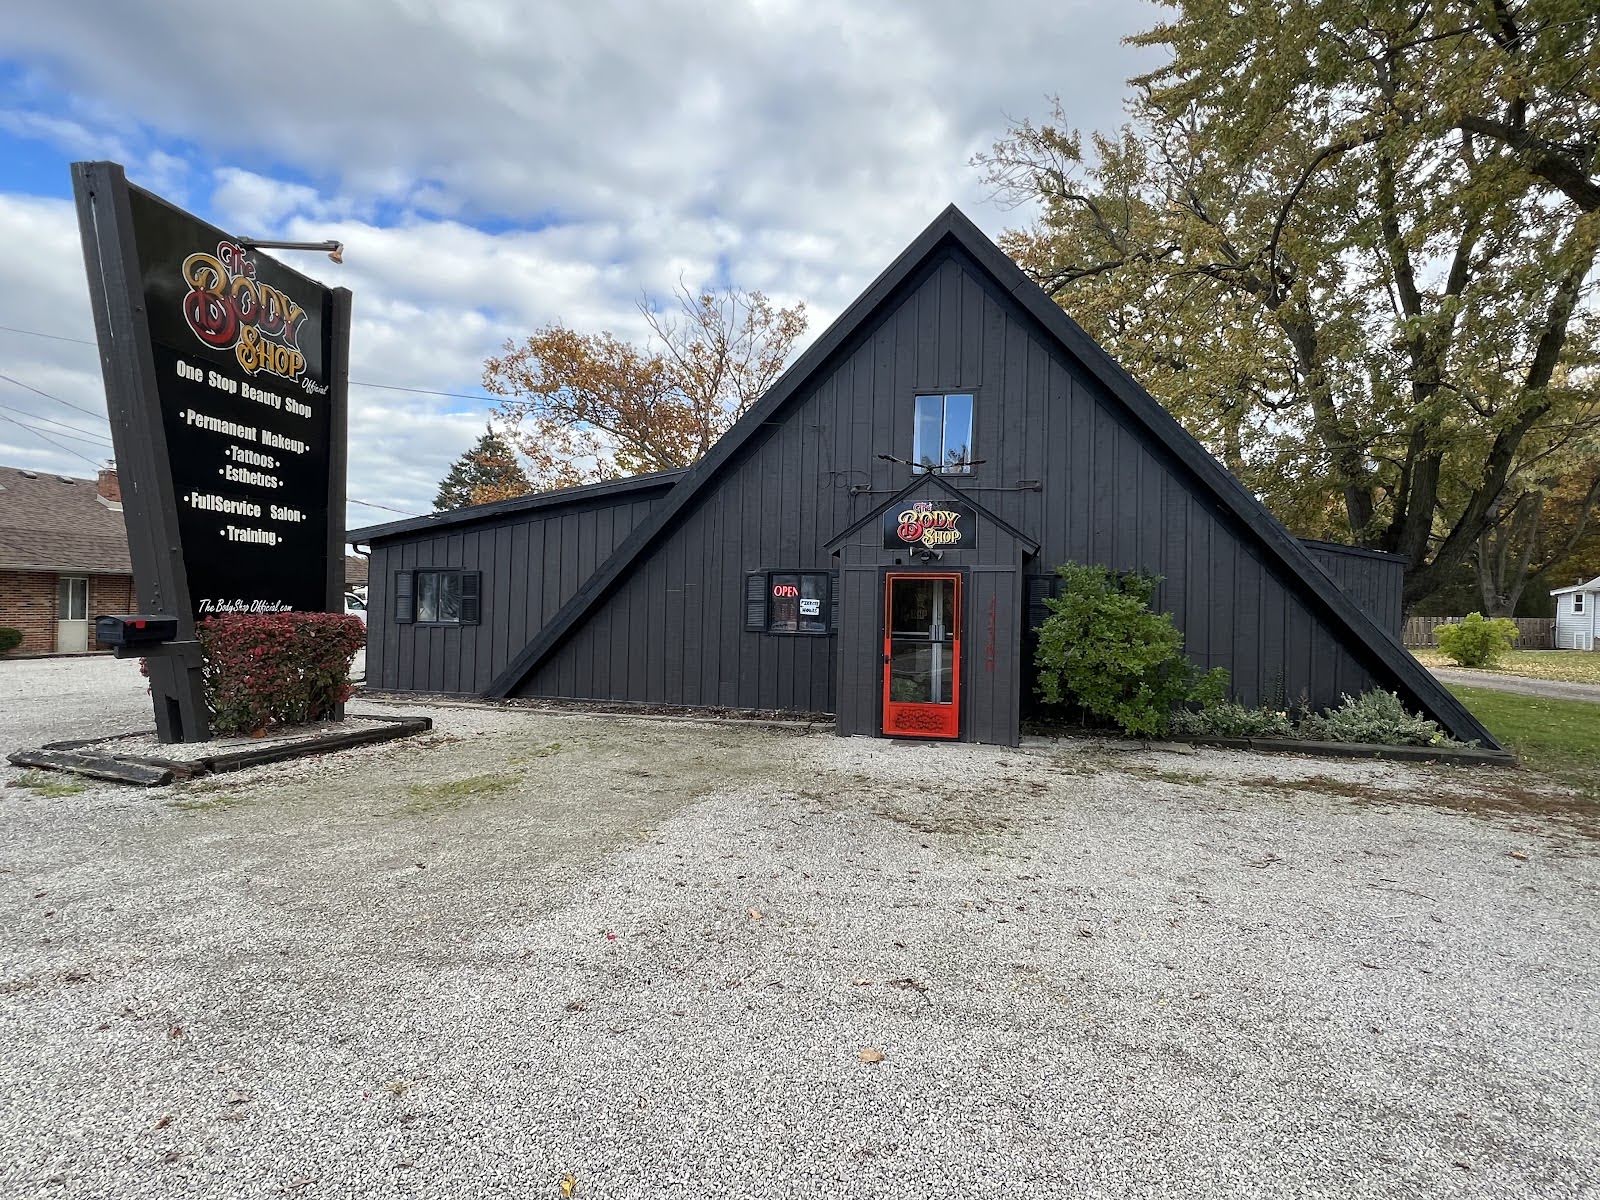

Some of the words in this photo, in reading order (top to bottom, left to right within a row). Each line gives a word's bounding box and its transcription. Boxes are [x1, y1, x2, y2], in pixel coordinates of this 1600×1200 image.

[217, 241, 257, 280] The
[182, 252, 308, 351] BODY
[235, 324, 307, 382] SHOP
[176, 360, 204, 382] One
[208, 370, 238, 394] Stop
[241, 381, 282, 410] Beauty
[285, 397, 312, 418] Shop
[301, 377, 330, 395] Official
[186, 408, 257, 442] Permanent
[261, 429, 305, 455] Makeup
[231, 445, 275, 469] Tattoos
[225, 464, 278, 488] Esthetics
[191, 491, 261, 517] FullService
[270, 504, 301, 522] Salon
[226, 525, 276, 546] Training
[897, 510, 961, 542] BODY
[922, 527, 961, 548] SHOP
[773, 585, 799, 597] OPEN
[198, 598, 215, 613] The
